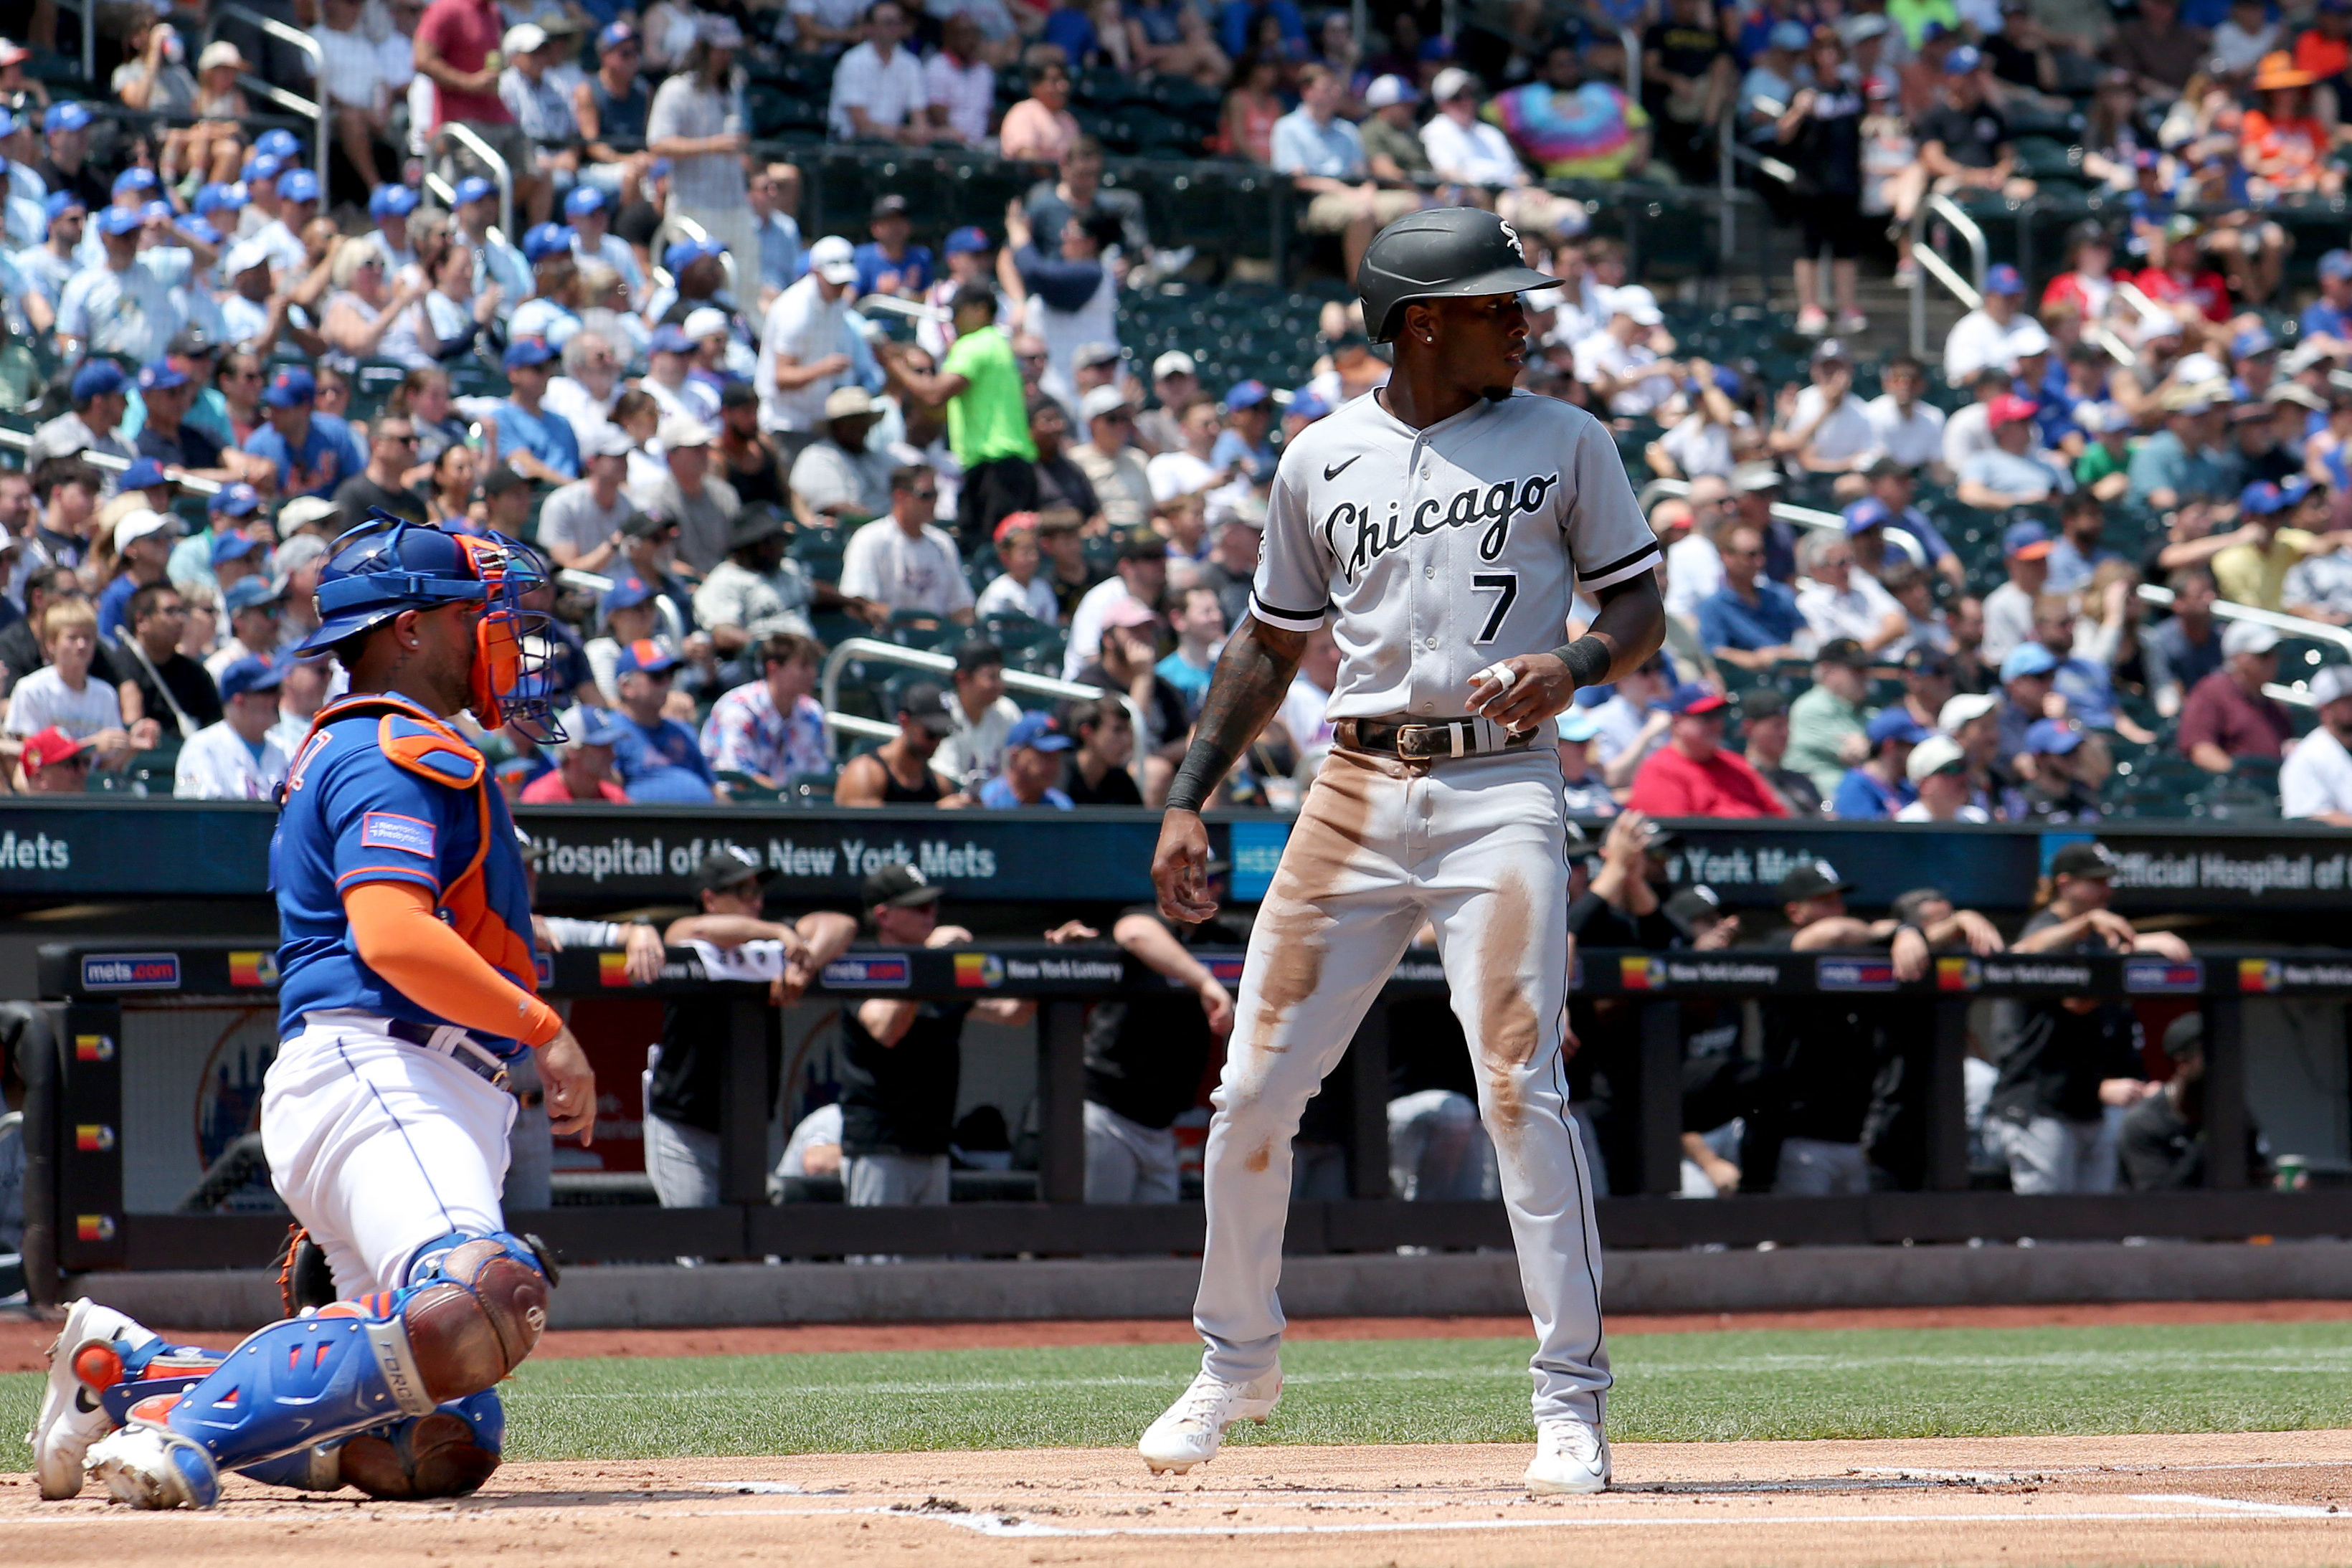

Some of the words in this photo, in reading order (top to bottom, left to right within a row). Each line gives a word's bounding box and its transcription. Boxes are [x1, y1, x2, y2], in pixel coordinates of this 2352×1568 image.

[1324, 472, 1559, 586] Chicago
[1470, 571, 1519, 645] 7
[768, 838, 837, 875] New
[840, 838, 913, 876] York
[919, 840, 997, 877] Mets
[1684, 847, 1754, 883] York
[87, 961, 174, 982] mets.com
